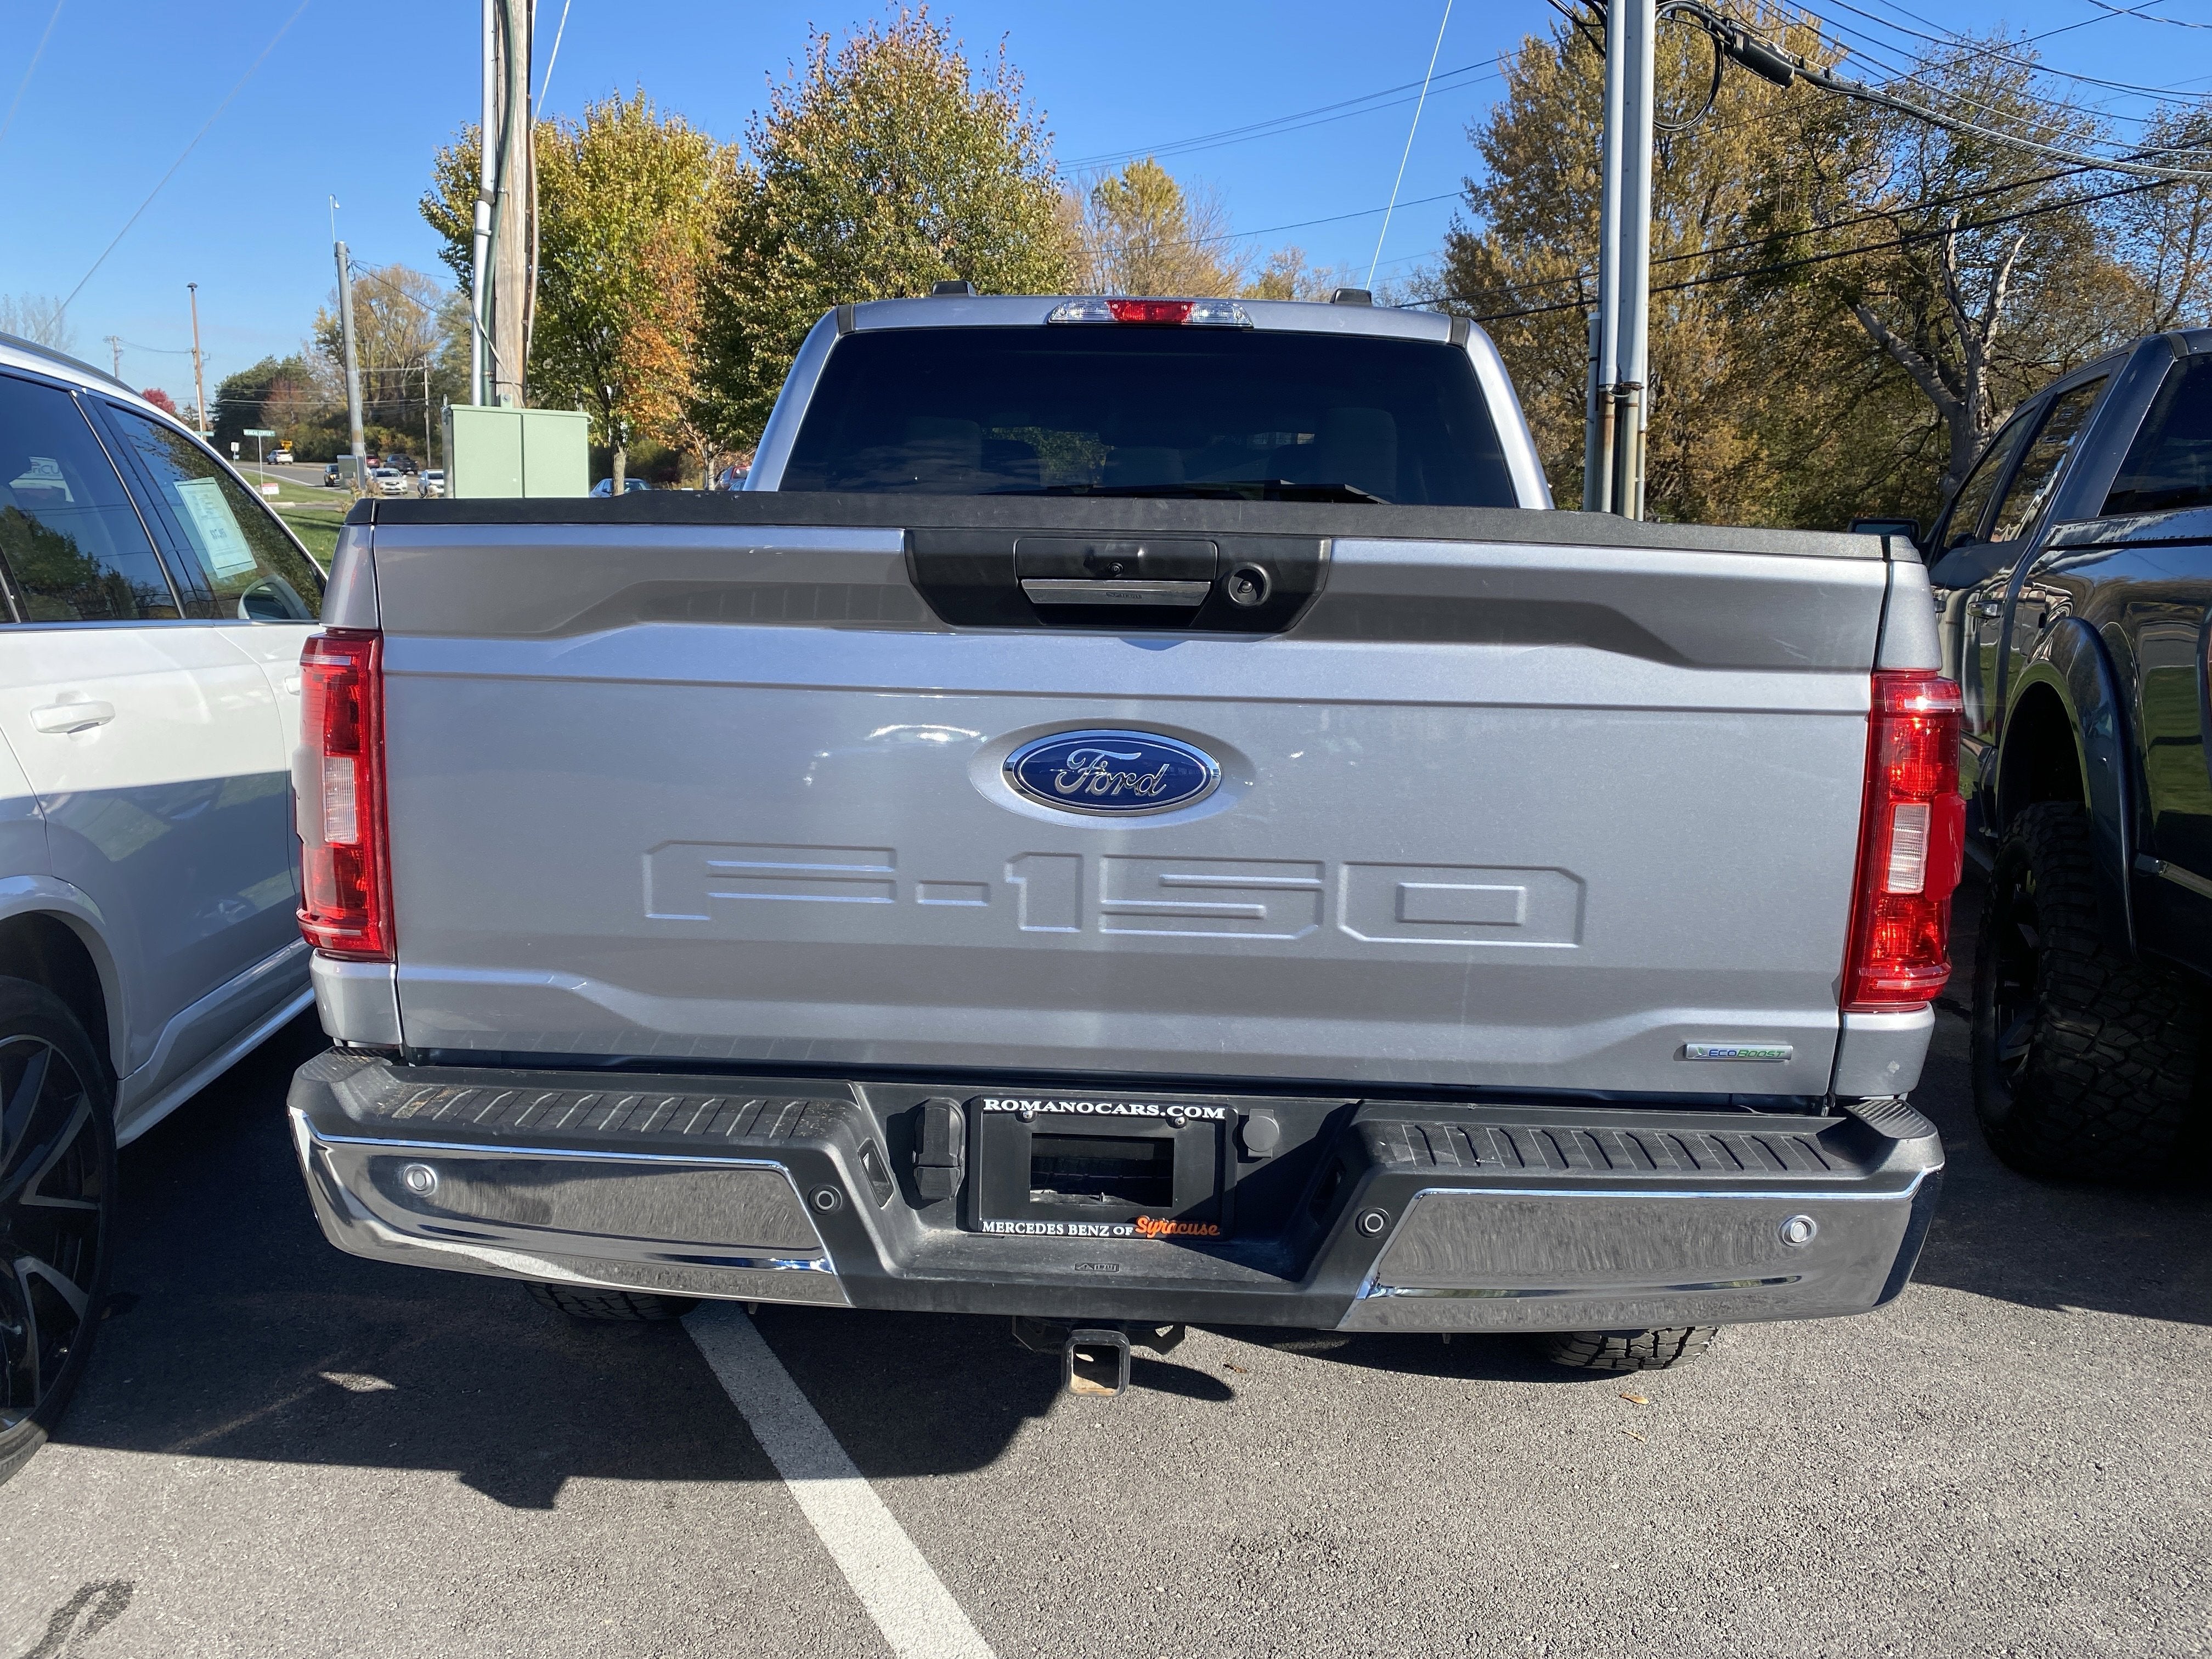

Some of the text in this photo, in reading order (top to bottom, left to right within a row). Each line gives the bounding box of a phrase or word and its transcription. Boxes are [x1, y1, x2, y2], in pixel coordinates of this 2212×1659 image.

[1054, 748, 1170, 798] Ford
[641, 839, 1588, 949] F-150
[983, 1099, 1226, 1119] ROMANOCARS.COM
[981, 1215, 1221, 1238] MERCEDES BENZ OF Syracuse
